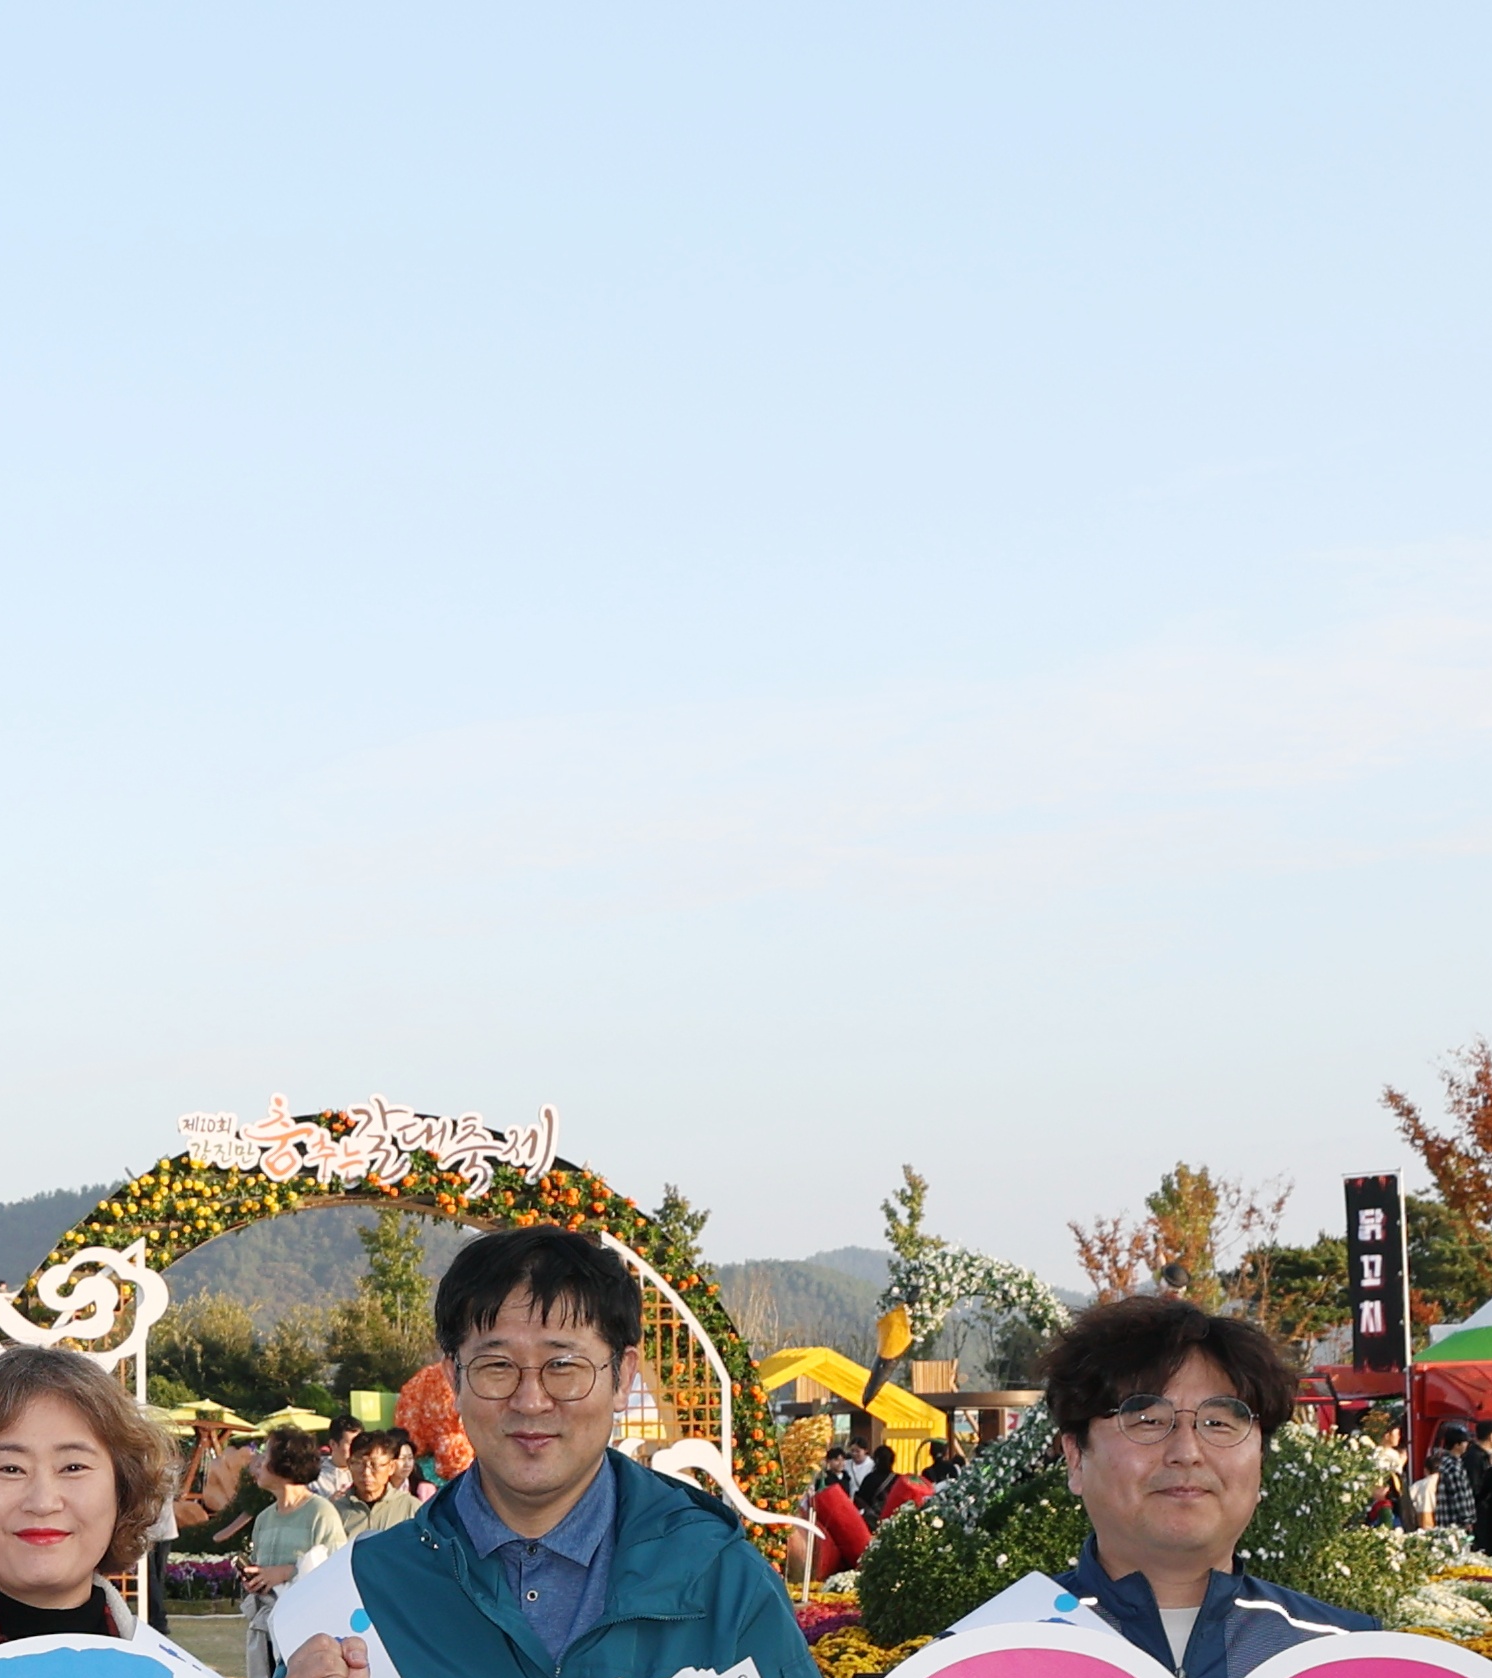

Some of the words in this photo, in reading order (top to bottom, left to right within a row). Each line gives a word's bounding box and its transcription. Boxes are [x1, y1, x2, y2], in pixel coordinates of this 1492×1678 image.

[182, 1117, 233, 1136] 제10회
[191, 1140, 258, 1163] 강진만
[1358, 1207, 1386, 1334] 닭꼬치
